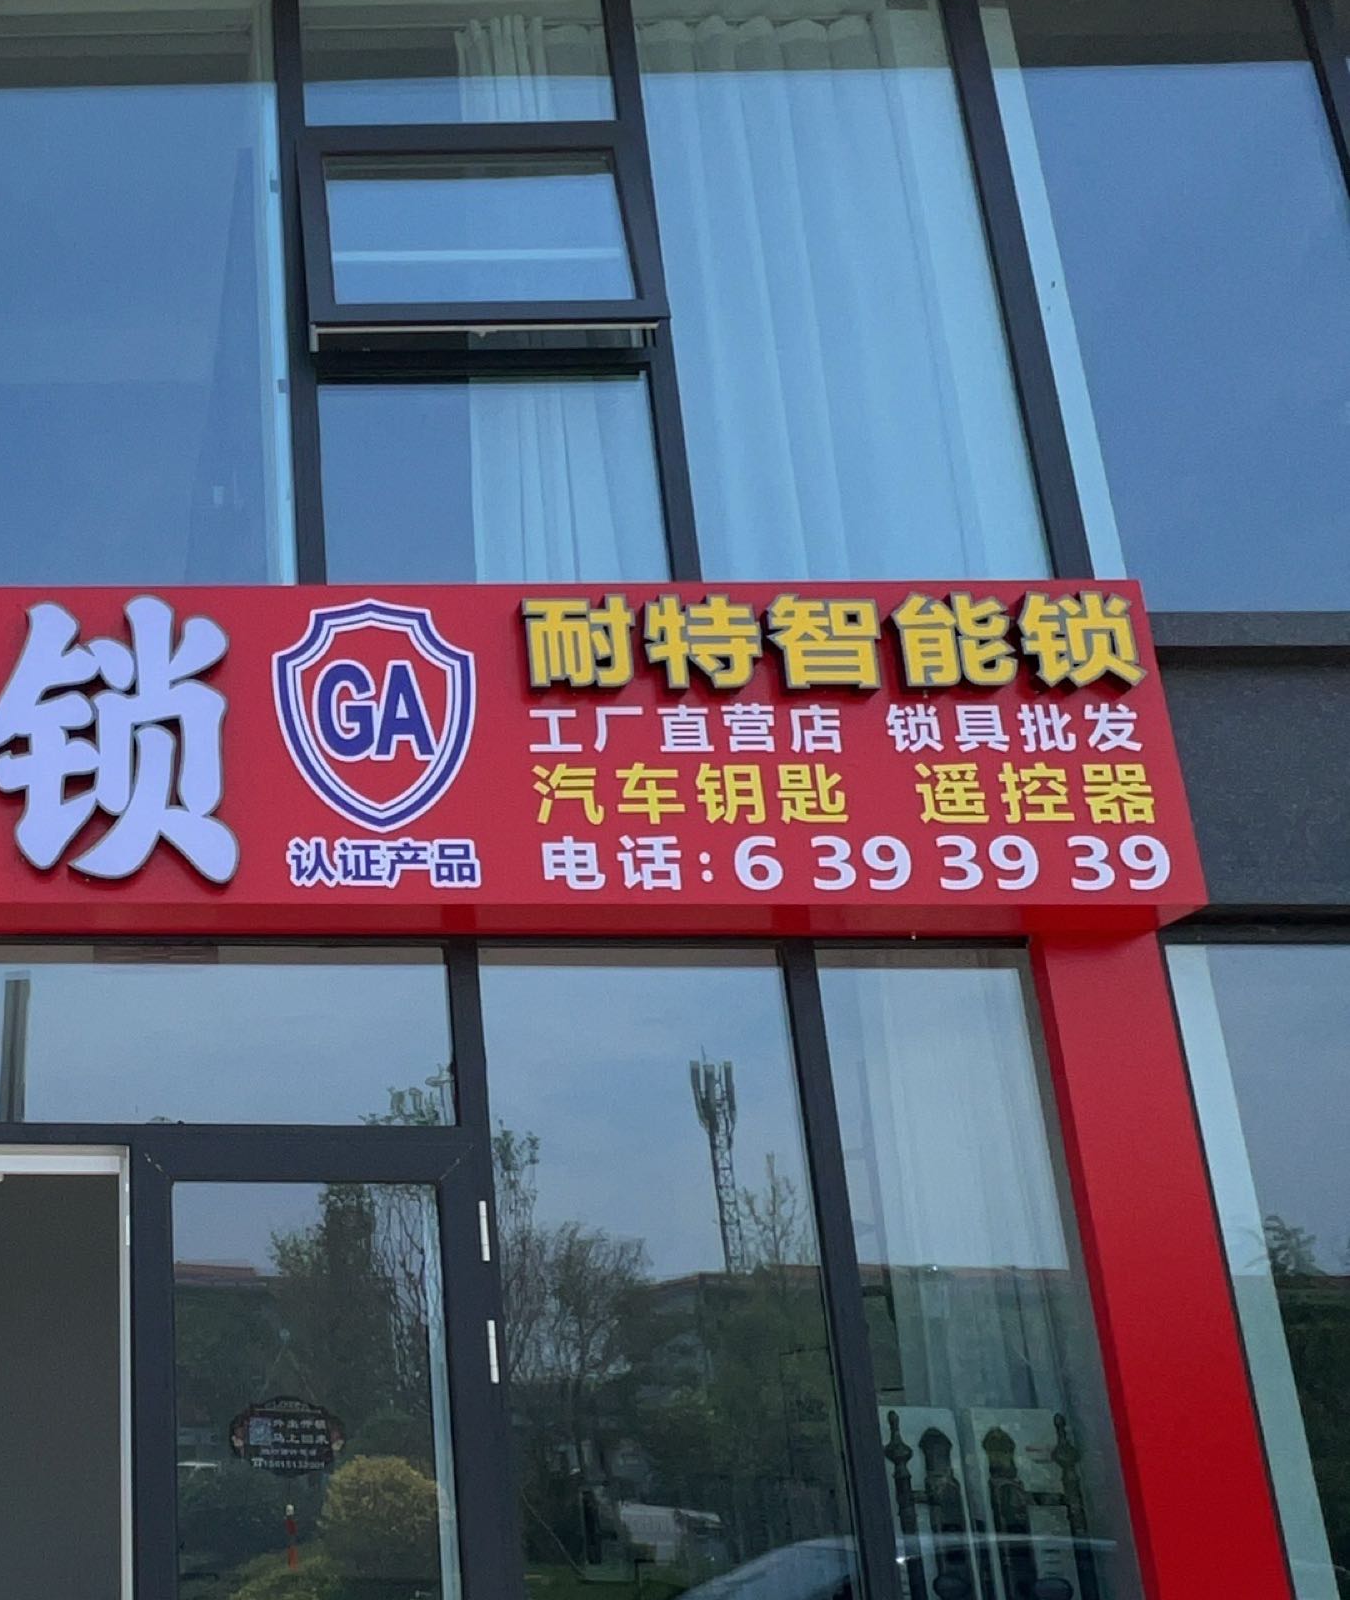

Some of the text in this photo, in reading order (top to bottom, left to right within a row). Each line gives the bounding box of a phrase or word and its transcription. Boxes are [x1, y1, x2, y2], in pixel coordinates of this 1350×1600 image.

[524, 592, 1145, 689] 耐特智能锁
[312, 658, 437, 764] GA
[528, 701, 1143, 754] 工厂直营店 锁具批发
[532, 761, 1156, 826] 汽车钥匙 遥控器
[287, 838, 482, 890] 认证产品
